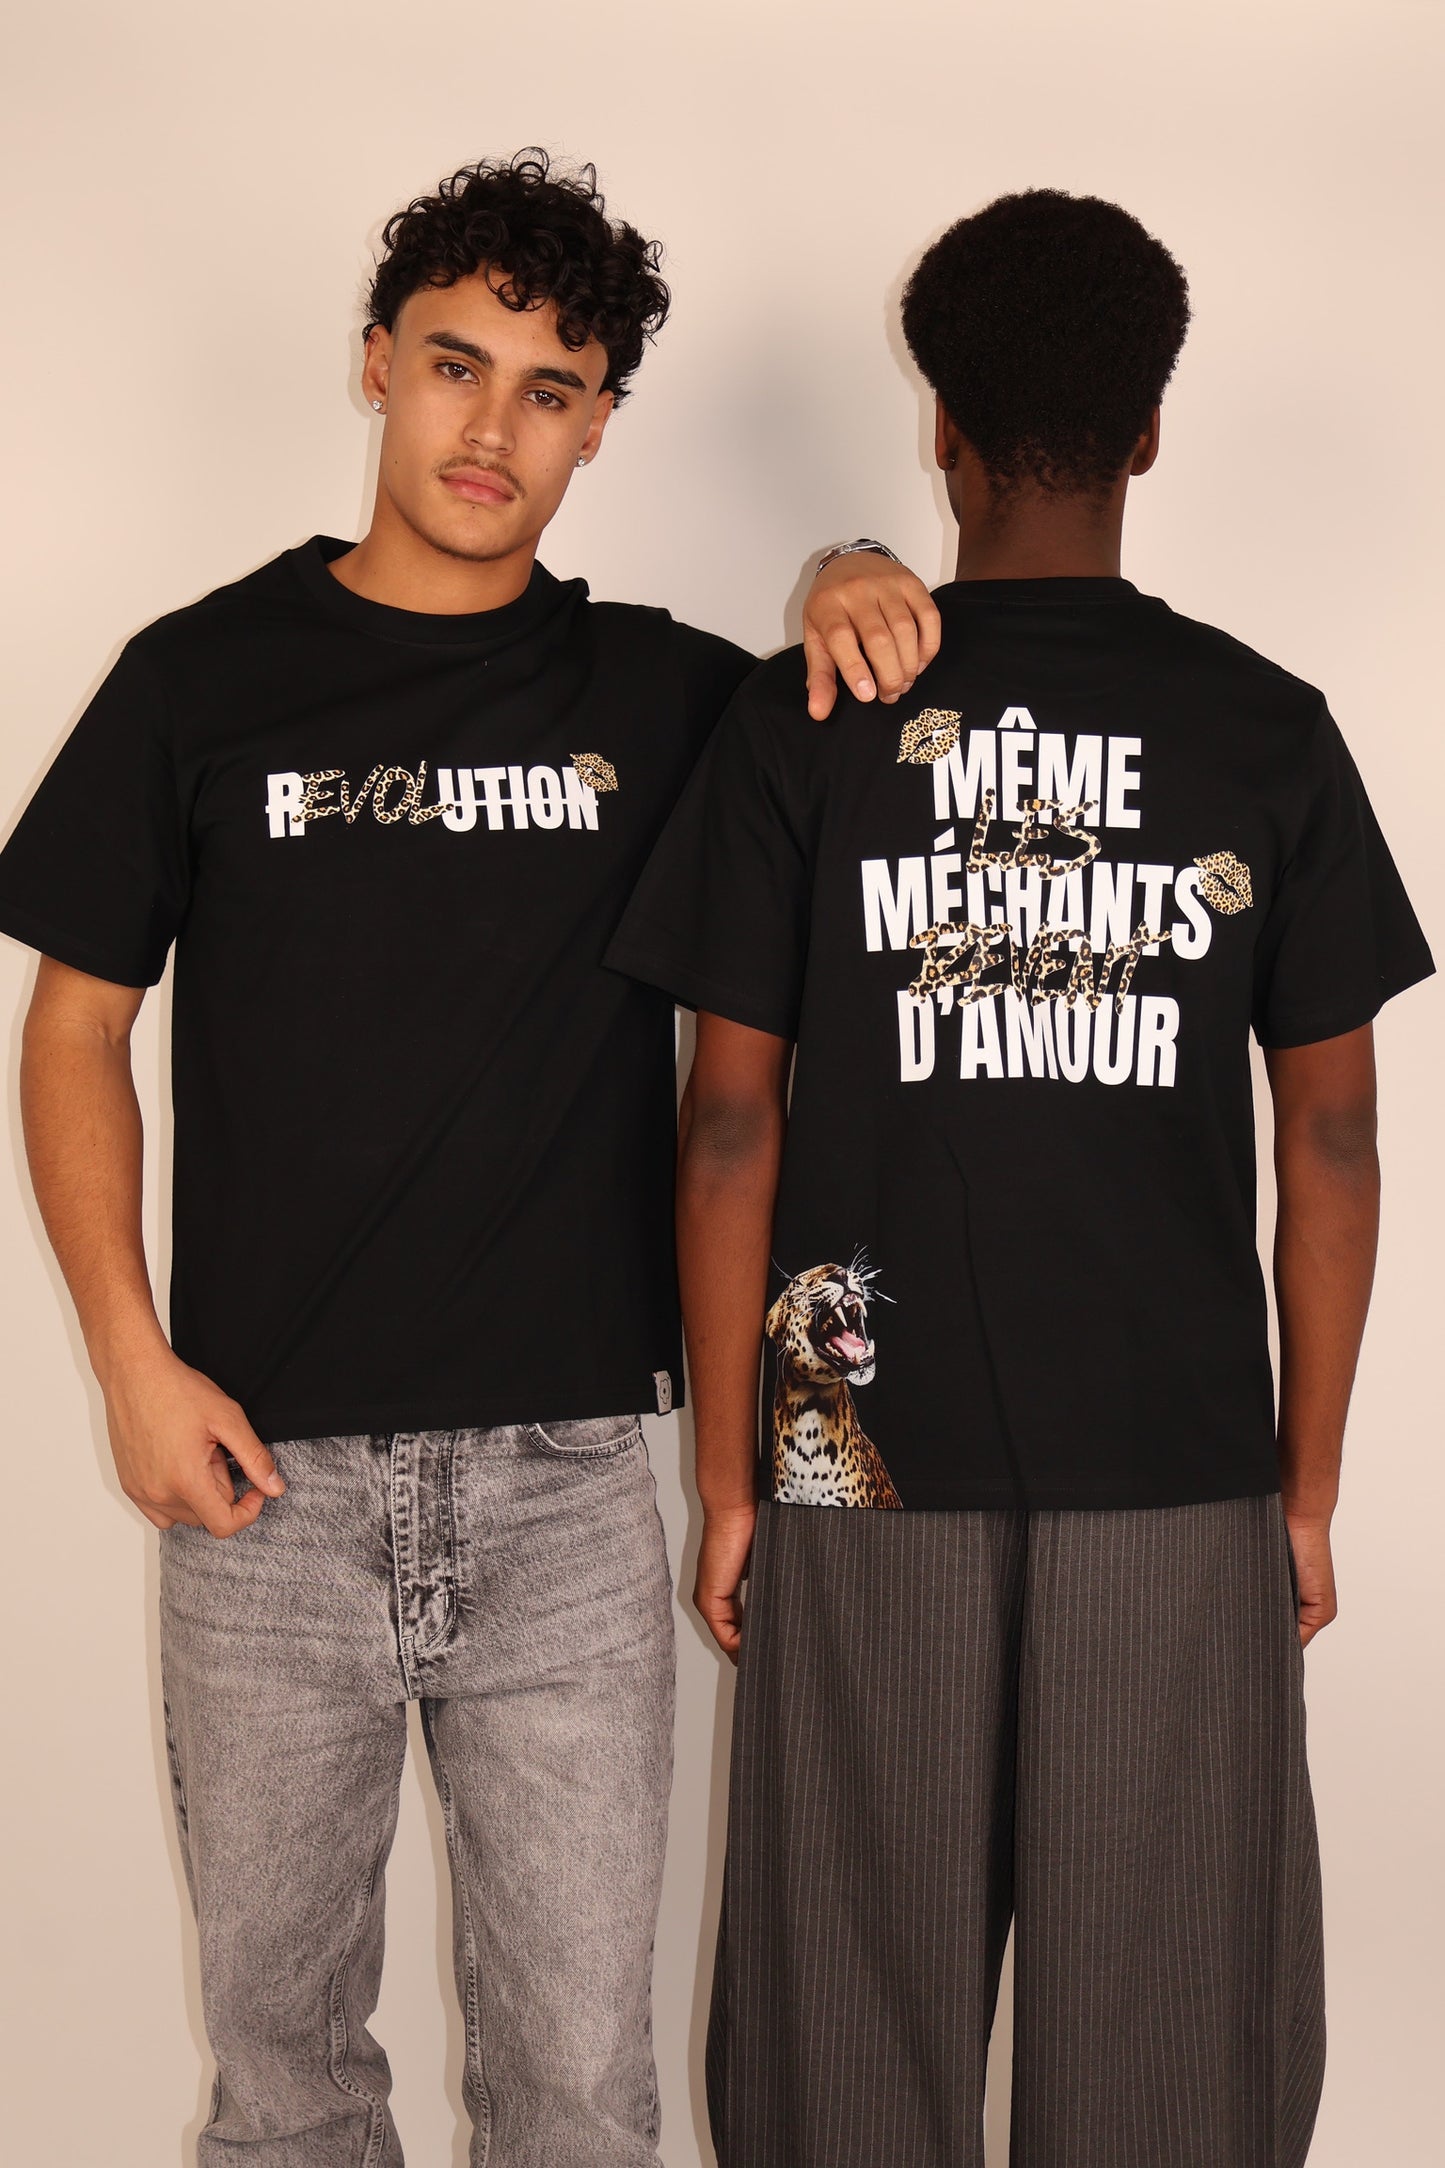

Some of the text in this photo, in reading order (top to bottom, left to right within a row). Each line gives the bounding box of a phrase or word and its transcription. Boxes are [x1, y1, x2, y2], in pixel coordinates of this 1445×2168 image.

[265, 760, 599, 838] REVOLUTION
[933, 706, 1142, 829] MÊME
[966, 787, 1102, 880] LES
[860, 826, 1213, 961] MÉCHANTS
